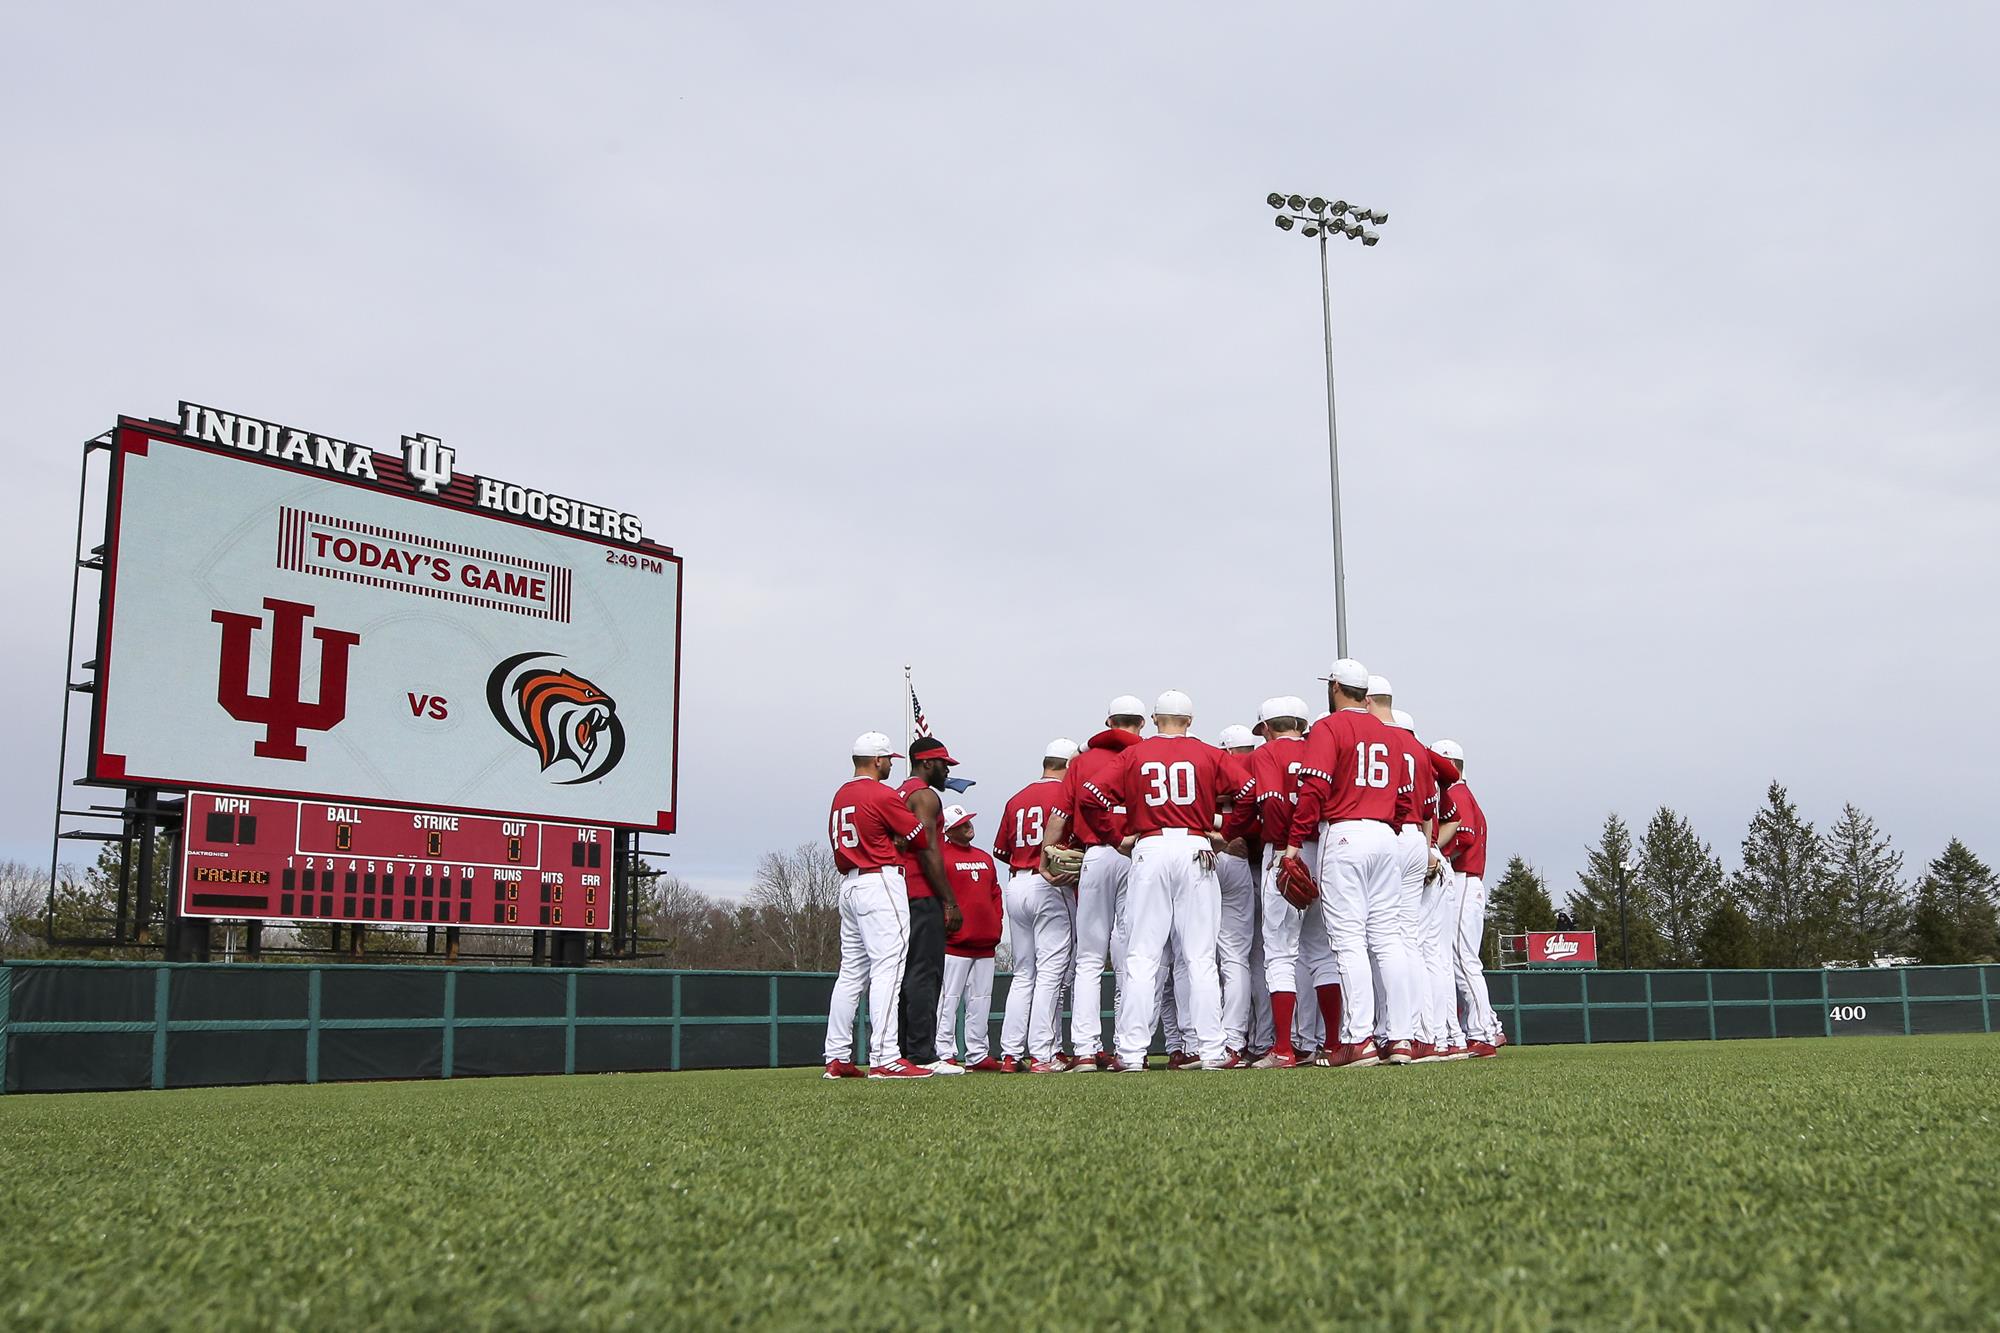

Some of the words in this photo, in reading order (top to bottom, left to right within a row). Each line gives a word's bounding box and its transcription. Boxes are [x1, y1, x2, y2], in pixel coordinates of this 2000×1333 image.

[183, 404, 378, 481] INDIANA
[477, 478, 642, 544] HOOSIERS
[311, 531, 451, 582] TODAY'S
[460, 564, 546, 602] GAME
[605, 550, 638, 568] 2:49
[641, 558, 662, 574] PM
[407, 692, 449, 720] VS
[1354, 741, 1389, 788] 16
[1140, 761, 1196, 807] 30
[215, 797, 250, 814] MPH
[327, 807, 362, 824] BALL
[413, 815, 459, 831] STRIKE
[502, 822, 527, 837] OUT
[831, 805, 860, 850] 45
[1015, 805, 1044, 848] 13
[337, 824, 351, 849] 0
[428, 831, 441, 855] 0
[578, 829, 597, 843] H/E
[508, 837, 521, 861] 0
[197, 867, 267, 884] PACIFIC
[287, 856, 293, 869] 1
[306, 857, 314, 870] 2
[326, 858, 334, 871] 3
[349, 859, 356, 872] 4
[367, 861, 375, 873] 5
[386, 862, 394, 874] 6
[408, 864, 416, 876] 7
[425, 864, 433, 876] 8
[443, 865, 450, 877] 9
[460, 866, 474, 879] 10
[493, 869, 522, 881] RUNS
[541, 871, 564, 884] HITS
[581, 874, 600, 886] ERR
[955, 862, 989, 871] INDIANA
[508, 882, 518, 900] 0
[553, 884, 563, 902] 0
[586, 886, 595, 904] 0
[507, 904, 517, 923] 0
[553, 906, 562, 924] 0
[585, 908, 595, 926] 0
[1543, 933, 1579, 956] Indiana
[1829, 1005, 1867, 1021] 400
